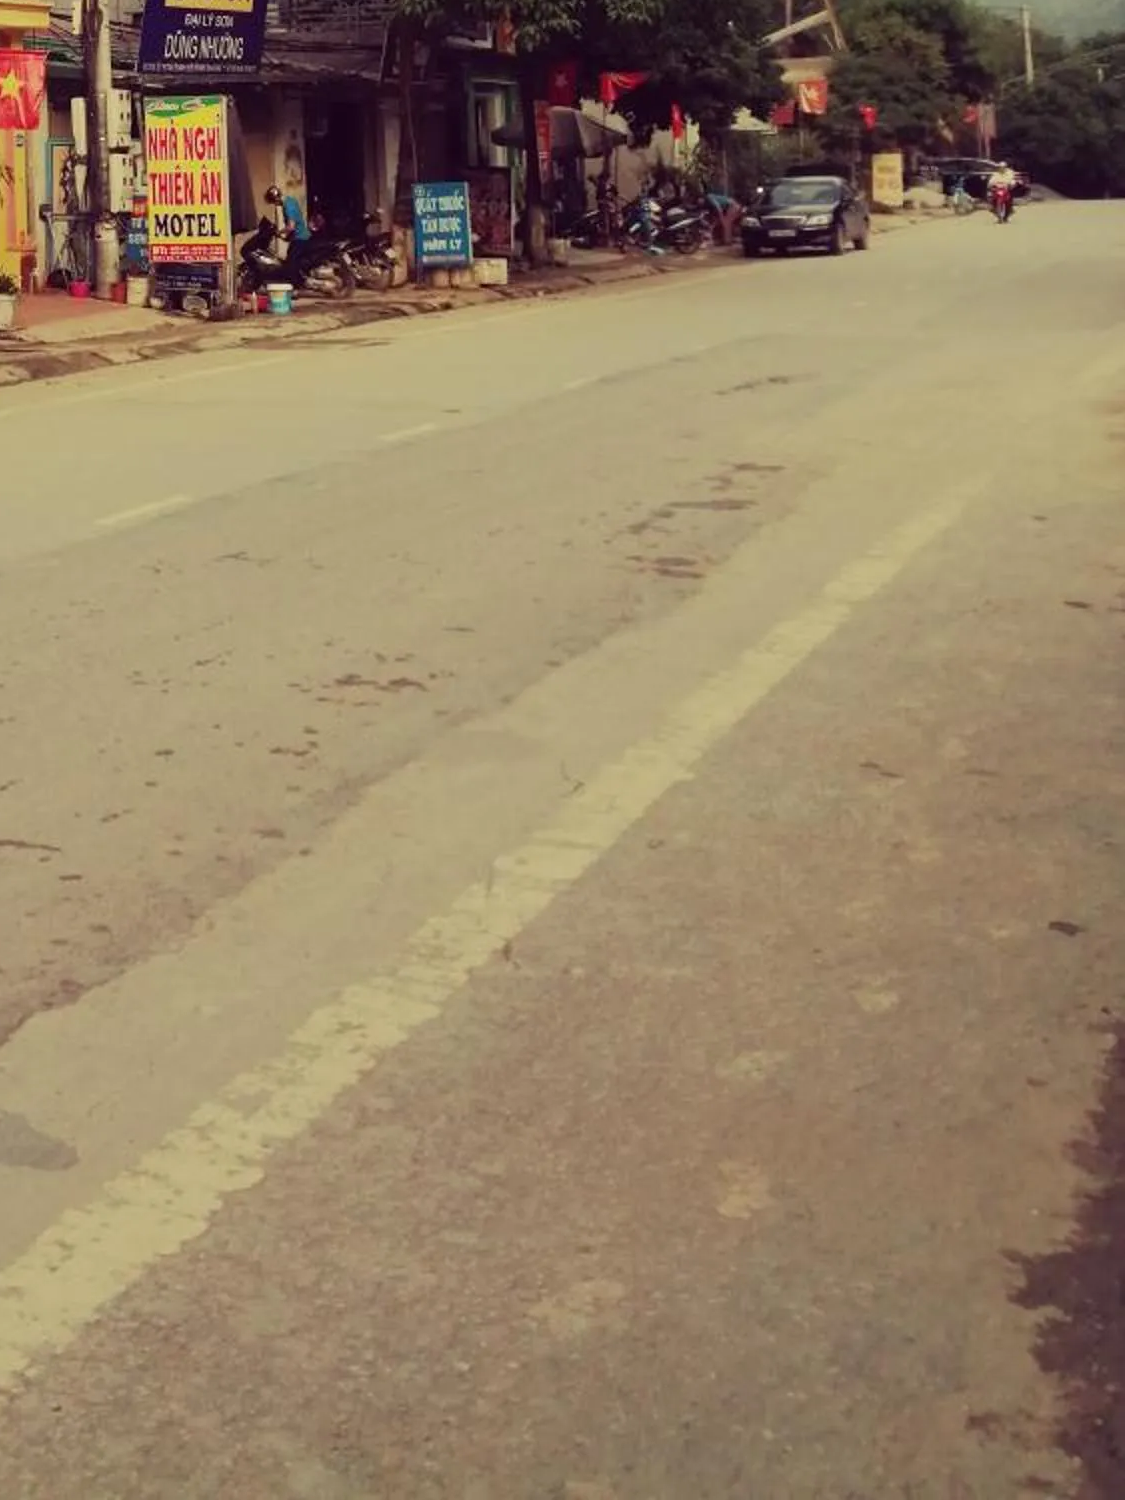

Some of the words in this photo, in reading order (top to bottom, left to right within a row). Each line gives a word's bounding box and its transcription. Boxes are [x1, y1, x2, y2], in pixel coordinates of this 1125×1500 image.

[148, 118, 178, 161] NHÀ
[183, 113, 220, 161] NGHỈ
[148, 164, 194, 206] THIÊN
[200, 164, 222, 206] ÂN
[154, 213, 221, 237] MOTEL
